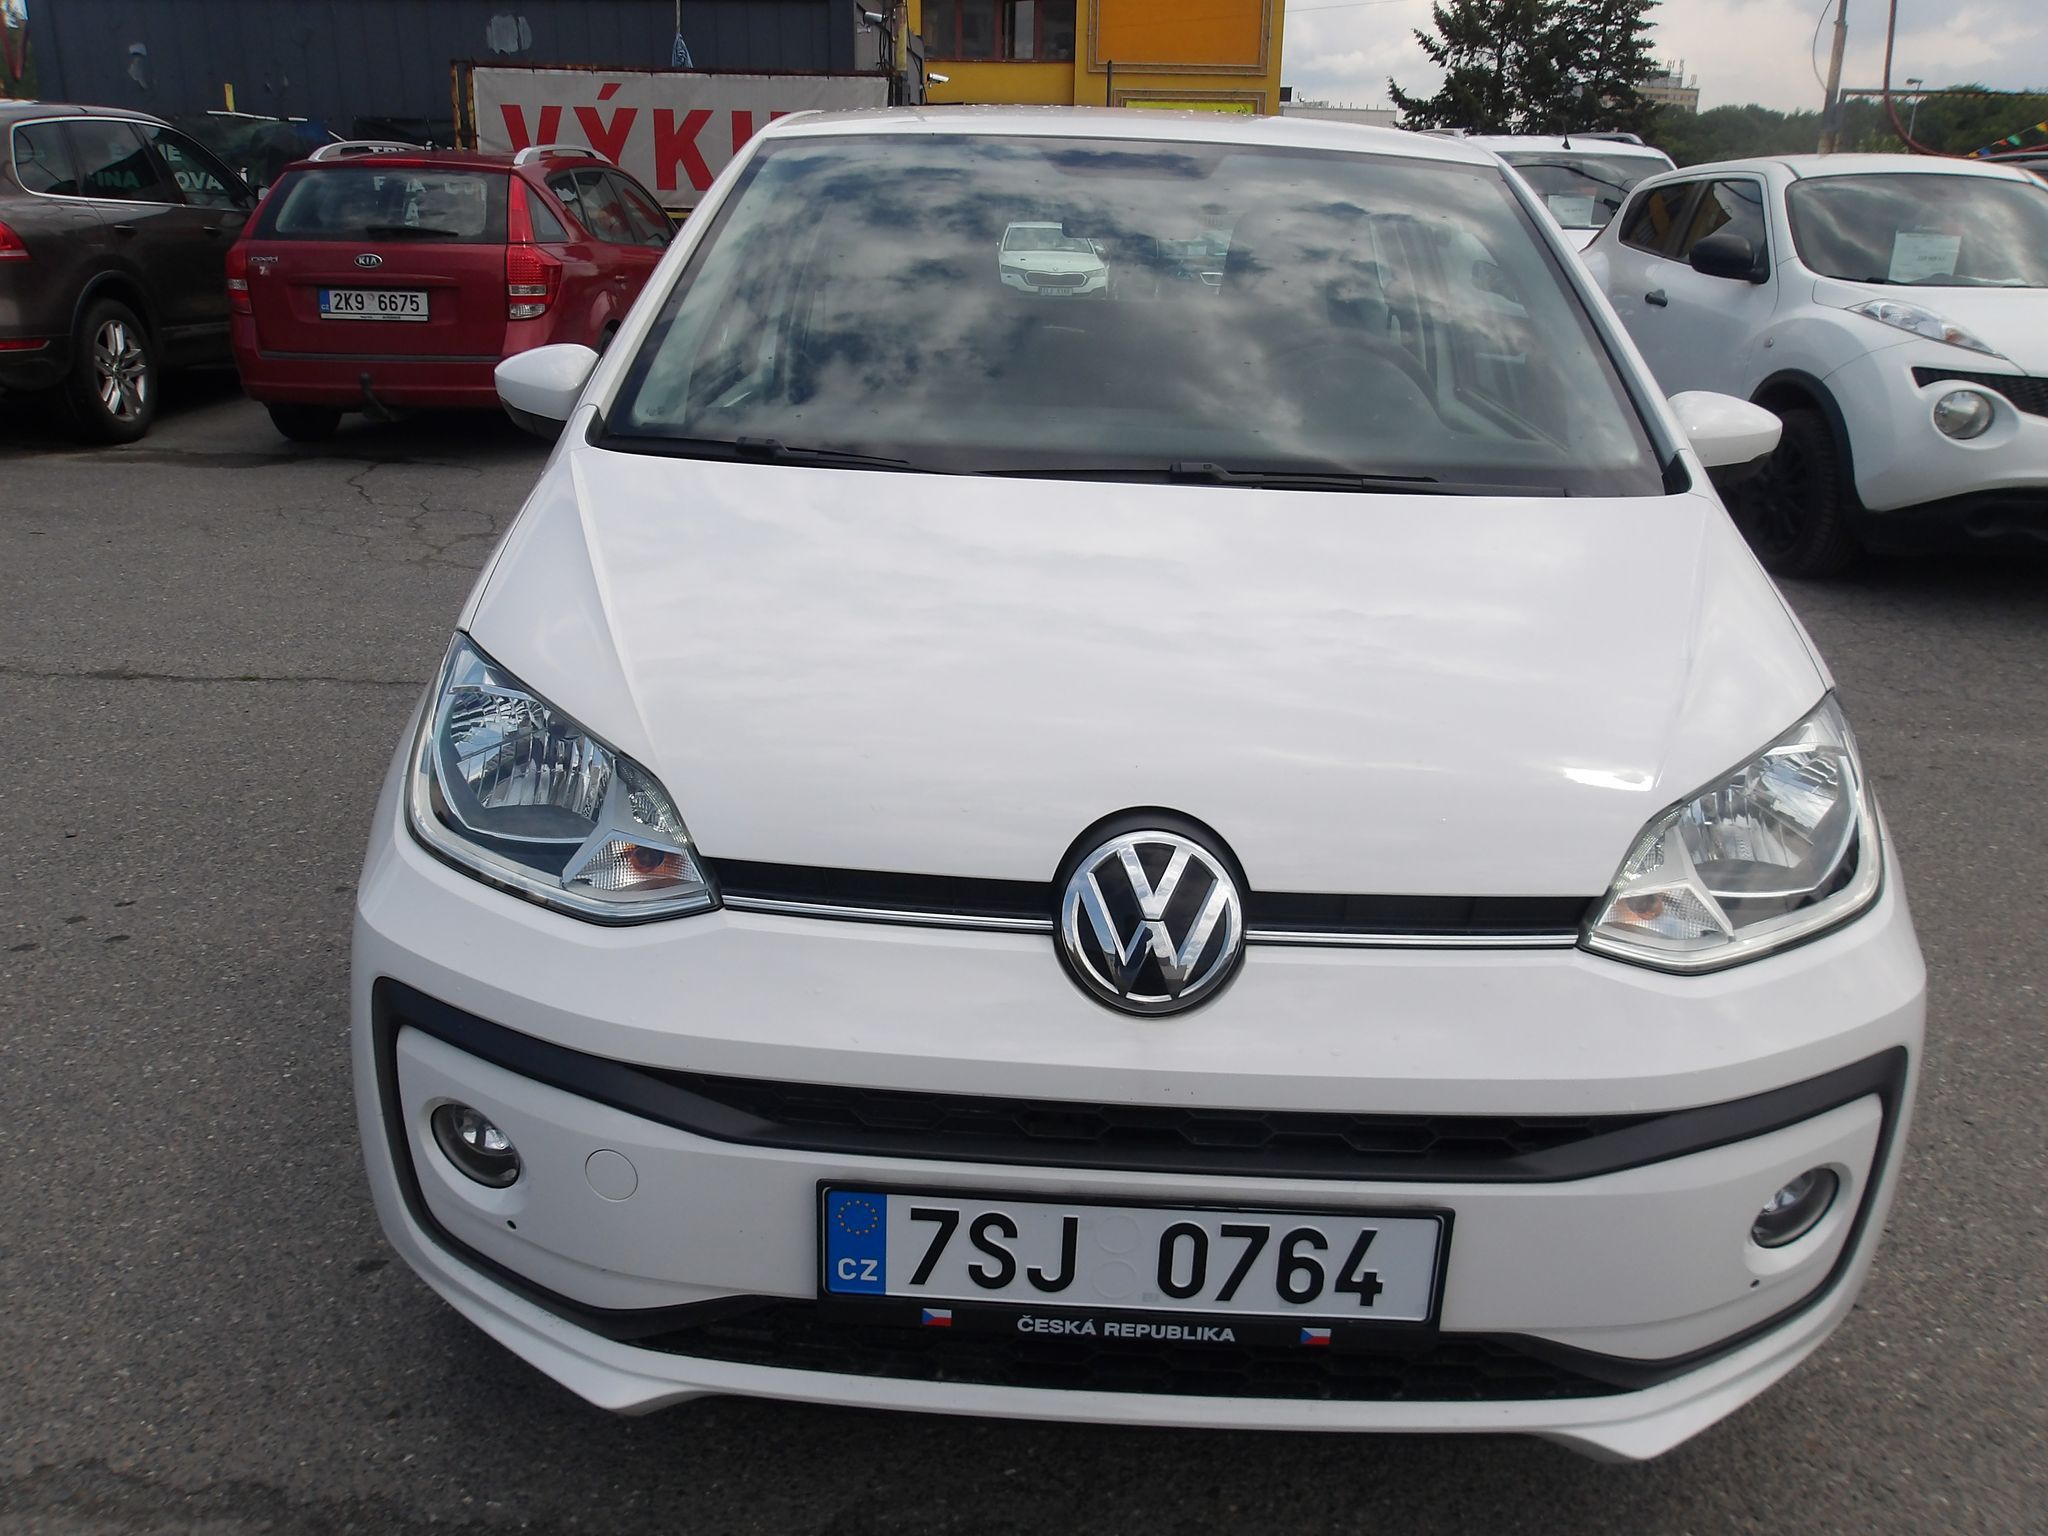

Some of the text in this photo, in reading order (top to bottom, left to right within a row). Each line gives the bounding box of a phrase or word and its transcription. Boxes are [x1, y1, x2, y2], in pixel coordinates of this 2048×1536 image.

[333, 293, 420, 312] 2K9 6675
[909, 1206, 1384, 1307] 7SJ 0764
[837, 1258, 878, 1281] CZ
[1017, 1315, 1235, 1342] ČESKÁ REPUBLIKA
